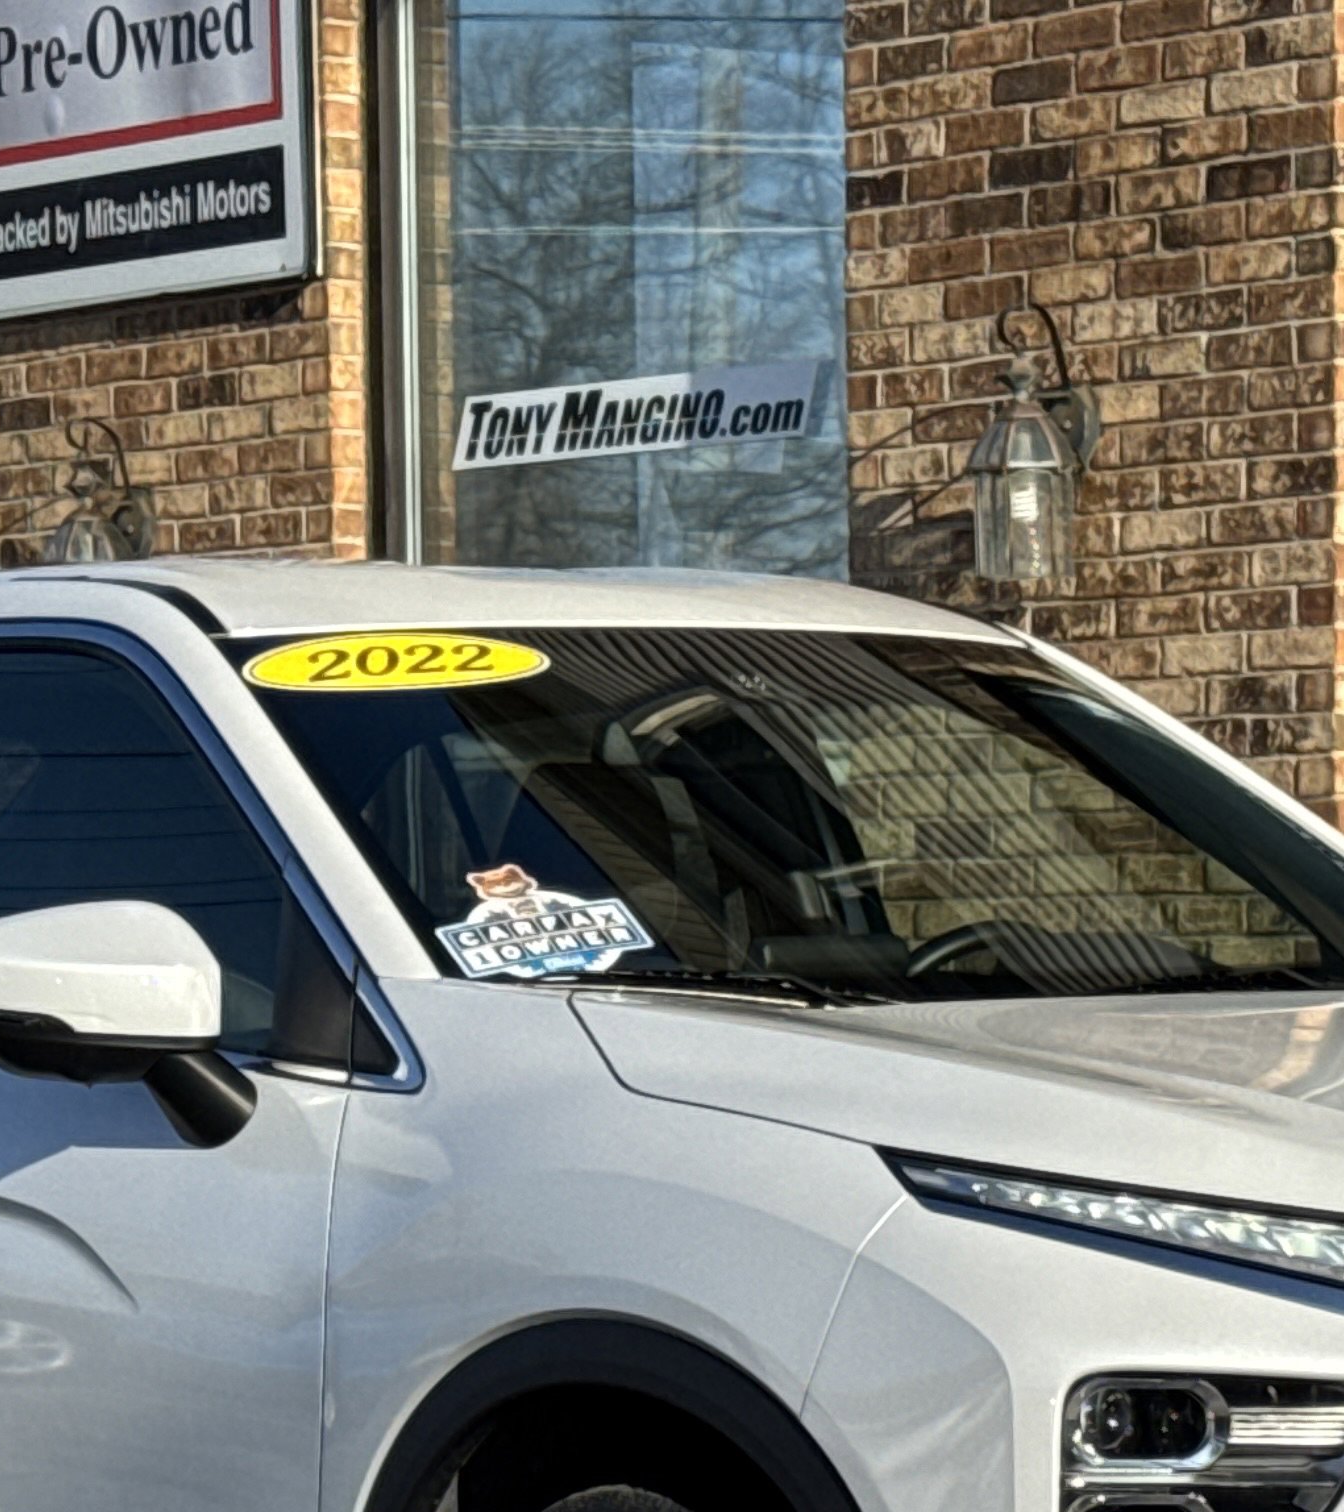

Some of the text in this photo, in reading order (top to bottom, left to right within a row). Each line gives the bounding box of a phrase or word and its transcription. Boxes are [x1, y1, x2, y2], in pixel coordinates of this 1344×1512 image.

[55, 204, 80, 254] by
[84, 183, 192, 240] Mitsubishi
[197, 180, 272, 224] Motors
[307, 643, 495, 683] 2022
[456, 909, 622, 948] CARFAX
